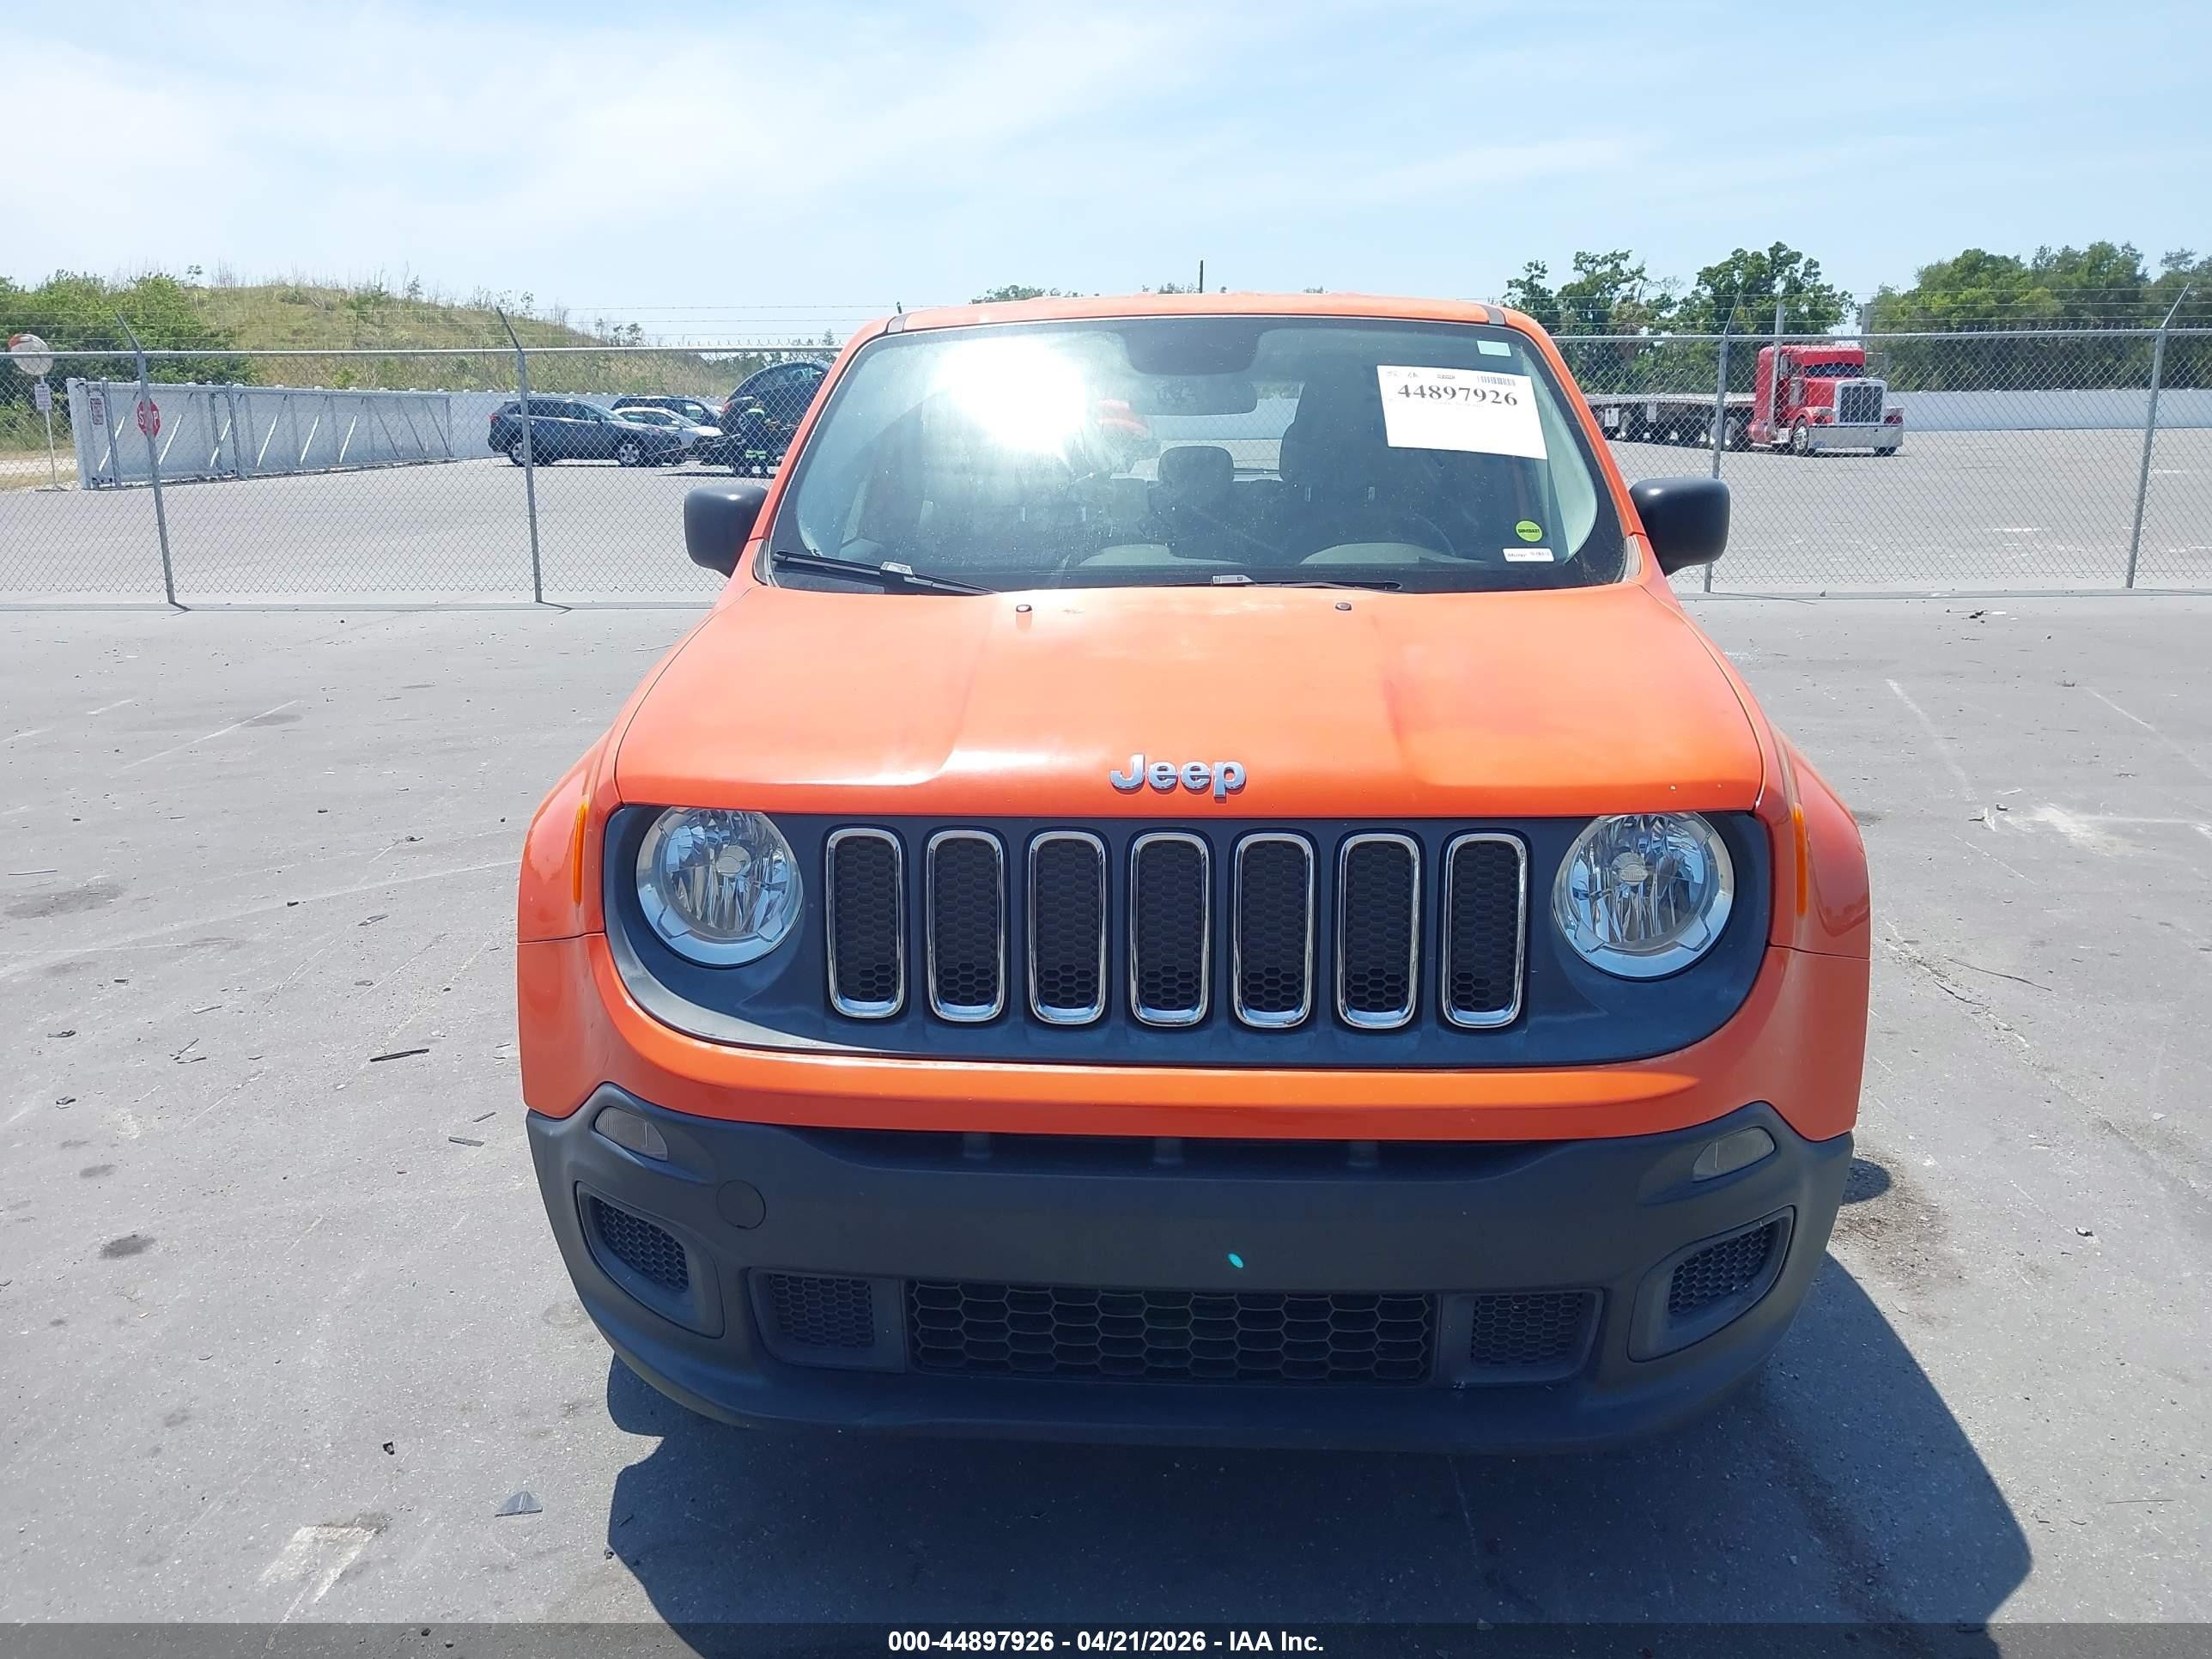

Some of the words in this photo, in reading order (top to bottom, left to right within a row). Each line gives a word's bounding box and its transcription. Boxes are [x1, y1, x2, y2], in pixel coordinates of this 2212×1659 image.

[1398, 384, 1518, 406] 44897926
[138, 410, 158, 427] SP
[1109, 754, 1246, 798] Jeep
